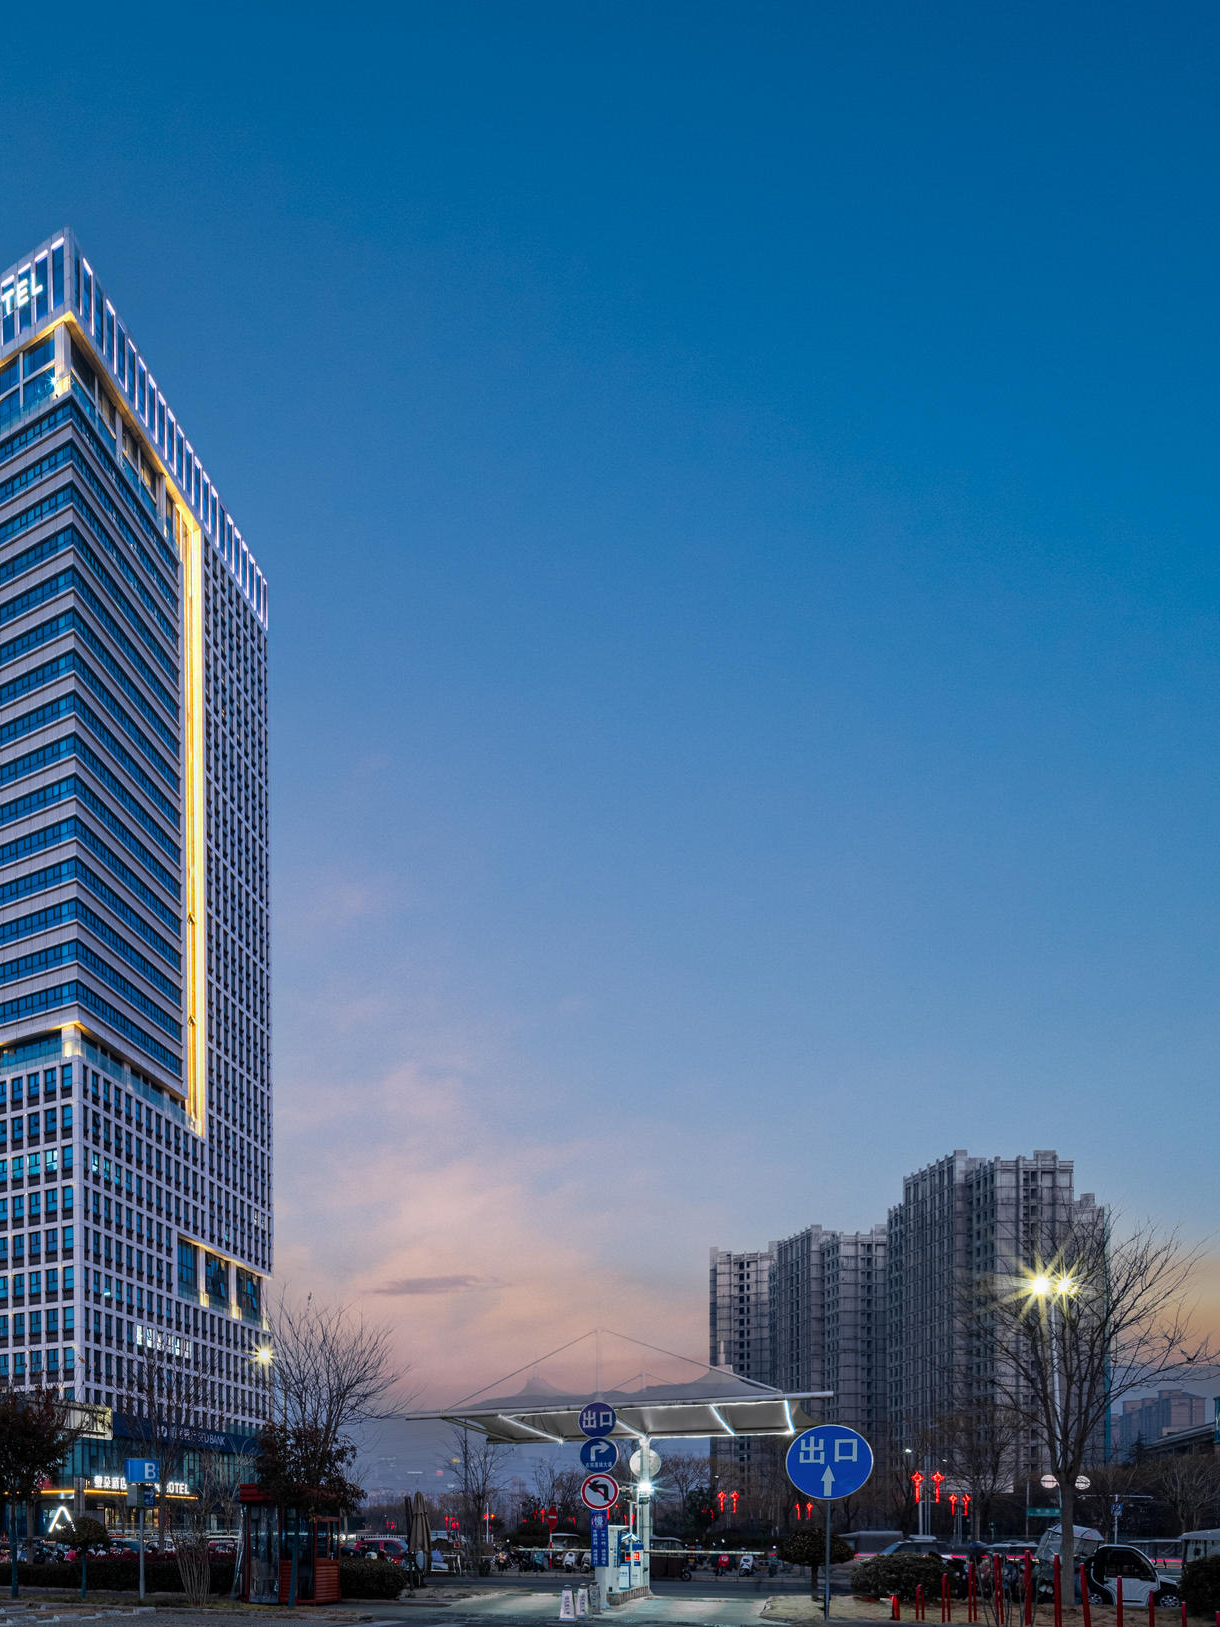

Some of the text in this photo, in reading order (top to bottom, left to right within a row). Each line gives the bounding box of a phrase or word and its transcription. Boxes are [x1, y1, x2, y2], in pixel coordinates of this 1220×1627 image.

[583, 1410, 612, 1428] 出口
[799, 1436, 858, 1464] 出口
[166, 1481, 190, 1494] OTEL
[594, 1515, 604, 1526] 慢
